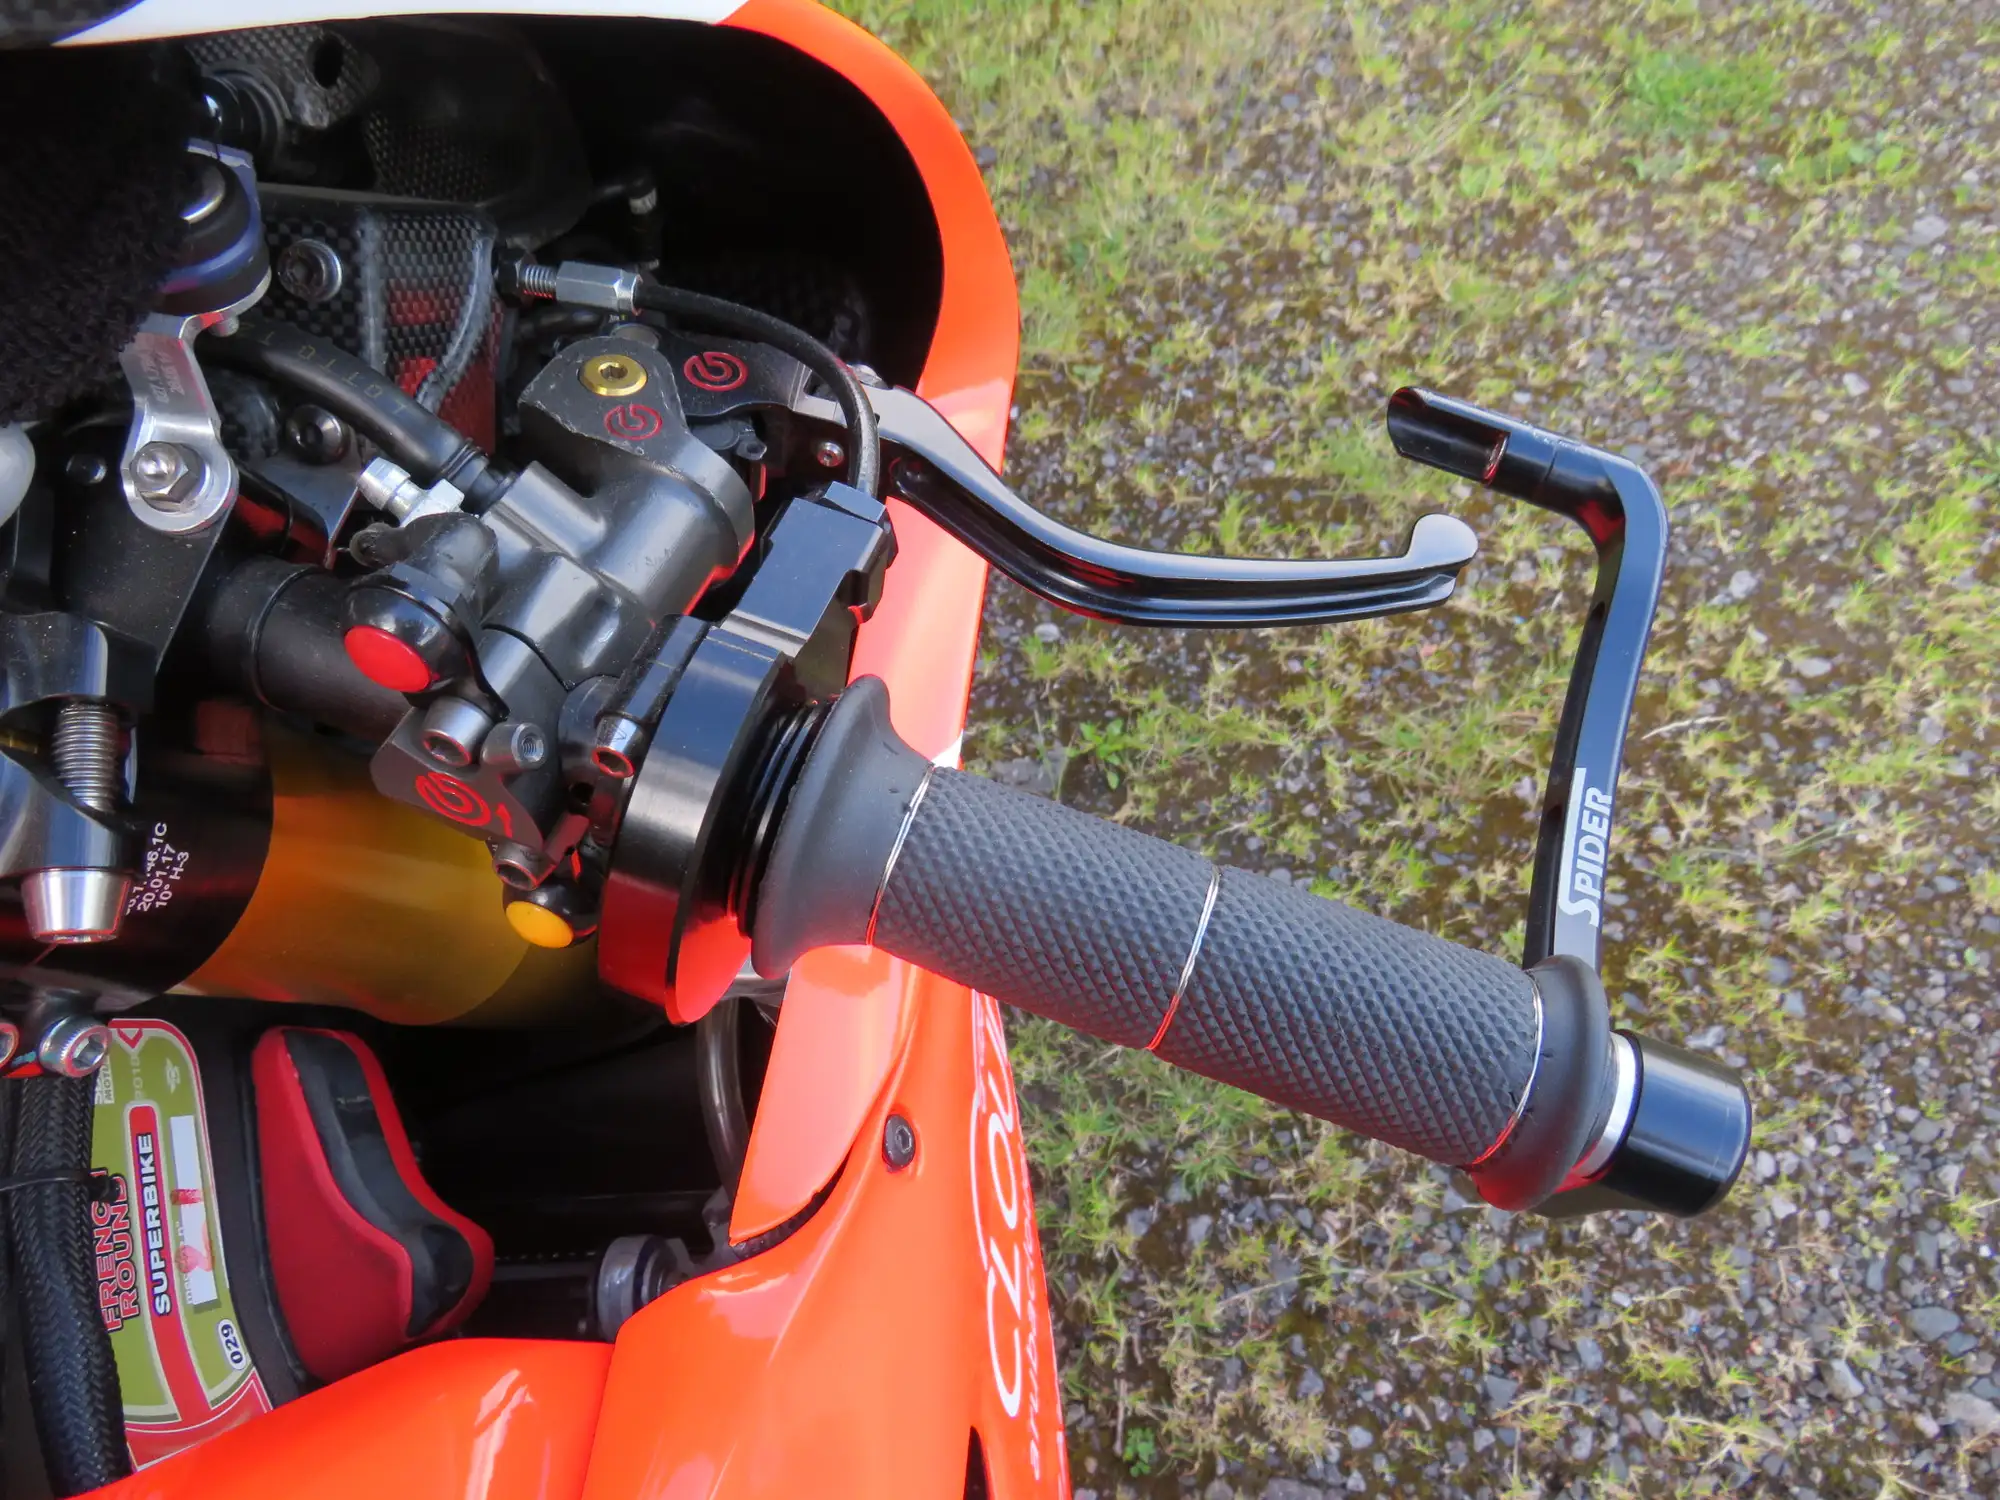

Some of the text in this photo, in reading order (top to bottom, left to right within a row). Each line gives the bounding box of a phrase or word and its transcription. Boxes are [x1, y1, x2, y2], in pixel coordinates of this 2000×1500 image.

[136, 842, 176, 912] 20.01.17
[1559, 768, 1613, 928] SPIDER
[137, 1132, 174, 1317] SUPERBIKE
[220, 1323, 244, 1365] 029
